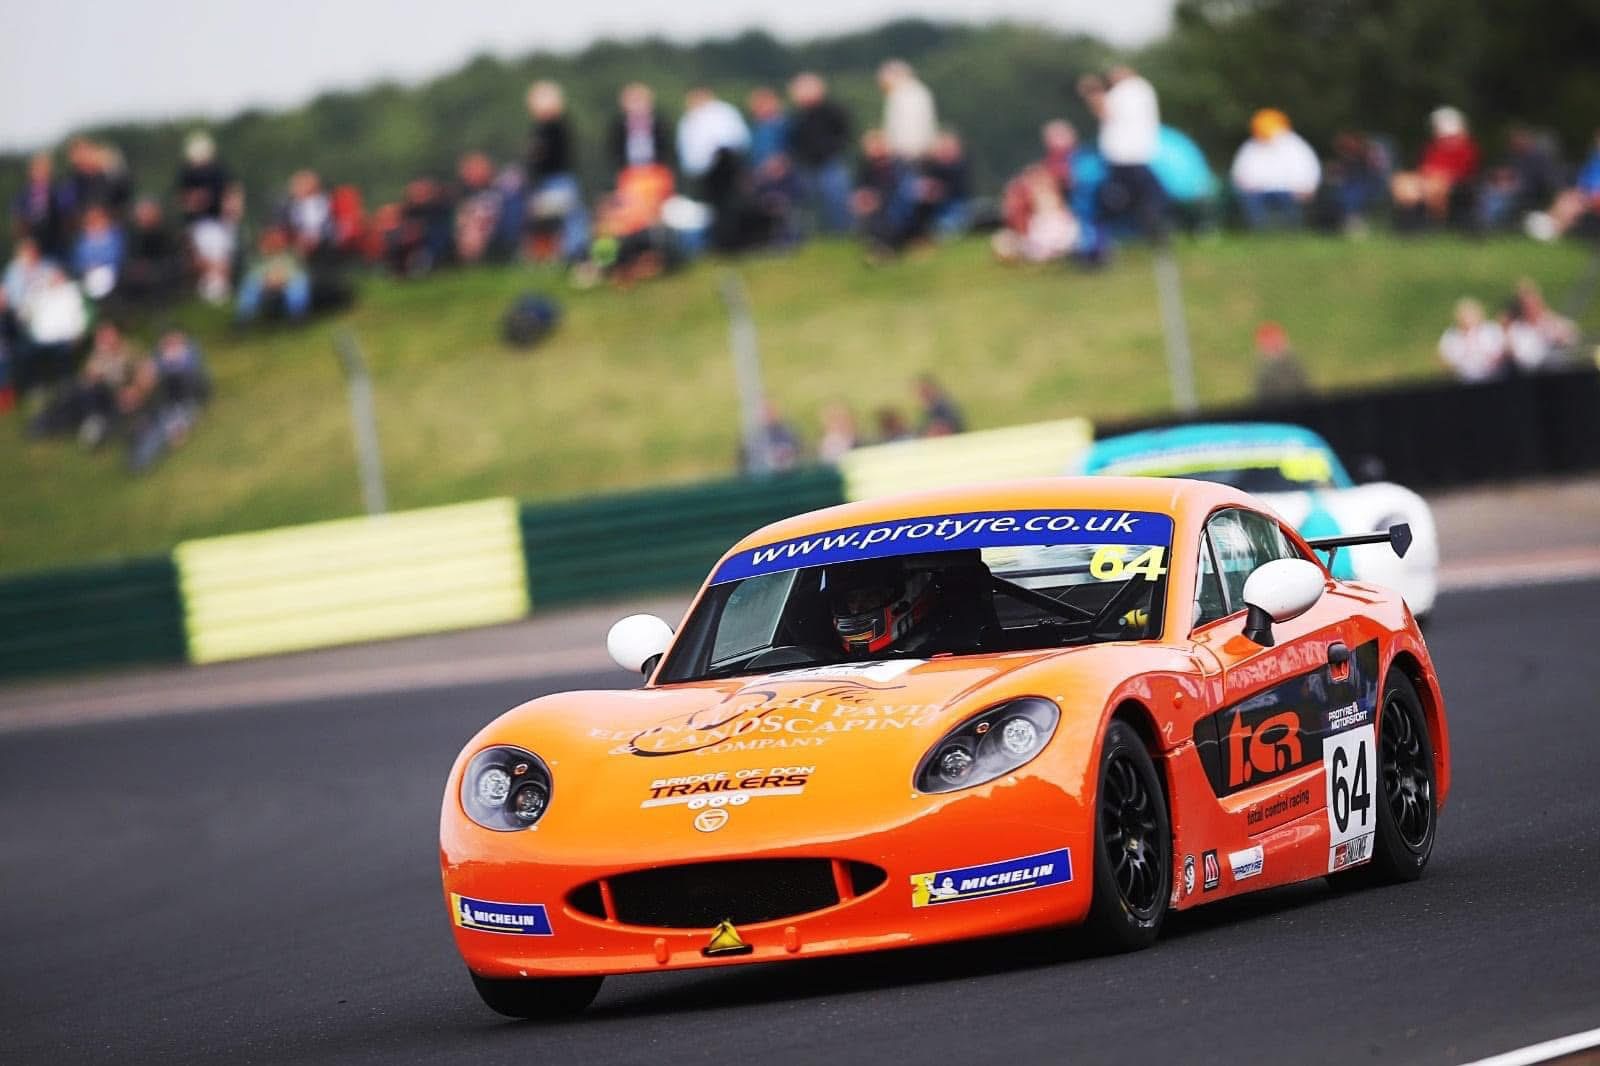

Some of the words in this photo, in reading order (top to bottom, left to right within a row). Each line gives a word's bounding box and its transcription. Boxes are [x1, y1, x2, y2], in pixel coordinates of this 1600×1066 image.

[752, 512, 1140, 566] www.protyre.co.uk
[1089, 545, 1167, 582] 64
[1331, 711, 1368, 730] MOTORSPORT
[695, 737, 829, 756] COMPANY
[650, 774, 809, 799] TRAILERS
[651, 771, 729, 788] BRIDGE
[735, 768, 764, 778] OF
[768, 765, 817, 775] DON
[1332, 740, 1371, 833] 64
[1264, 795, 1288, 819] control
[1289, 787, 1310, 809] racing
[960, 863, 1054, 891] MICHELIN
[473, 910, 535, 926] MICHELIN
